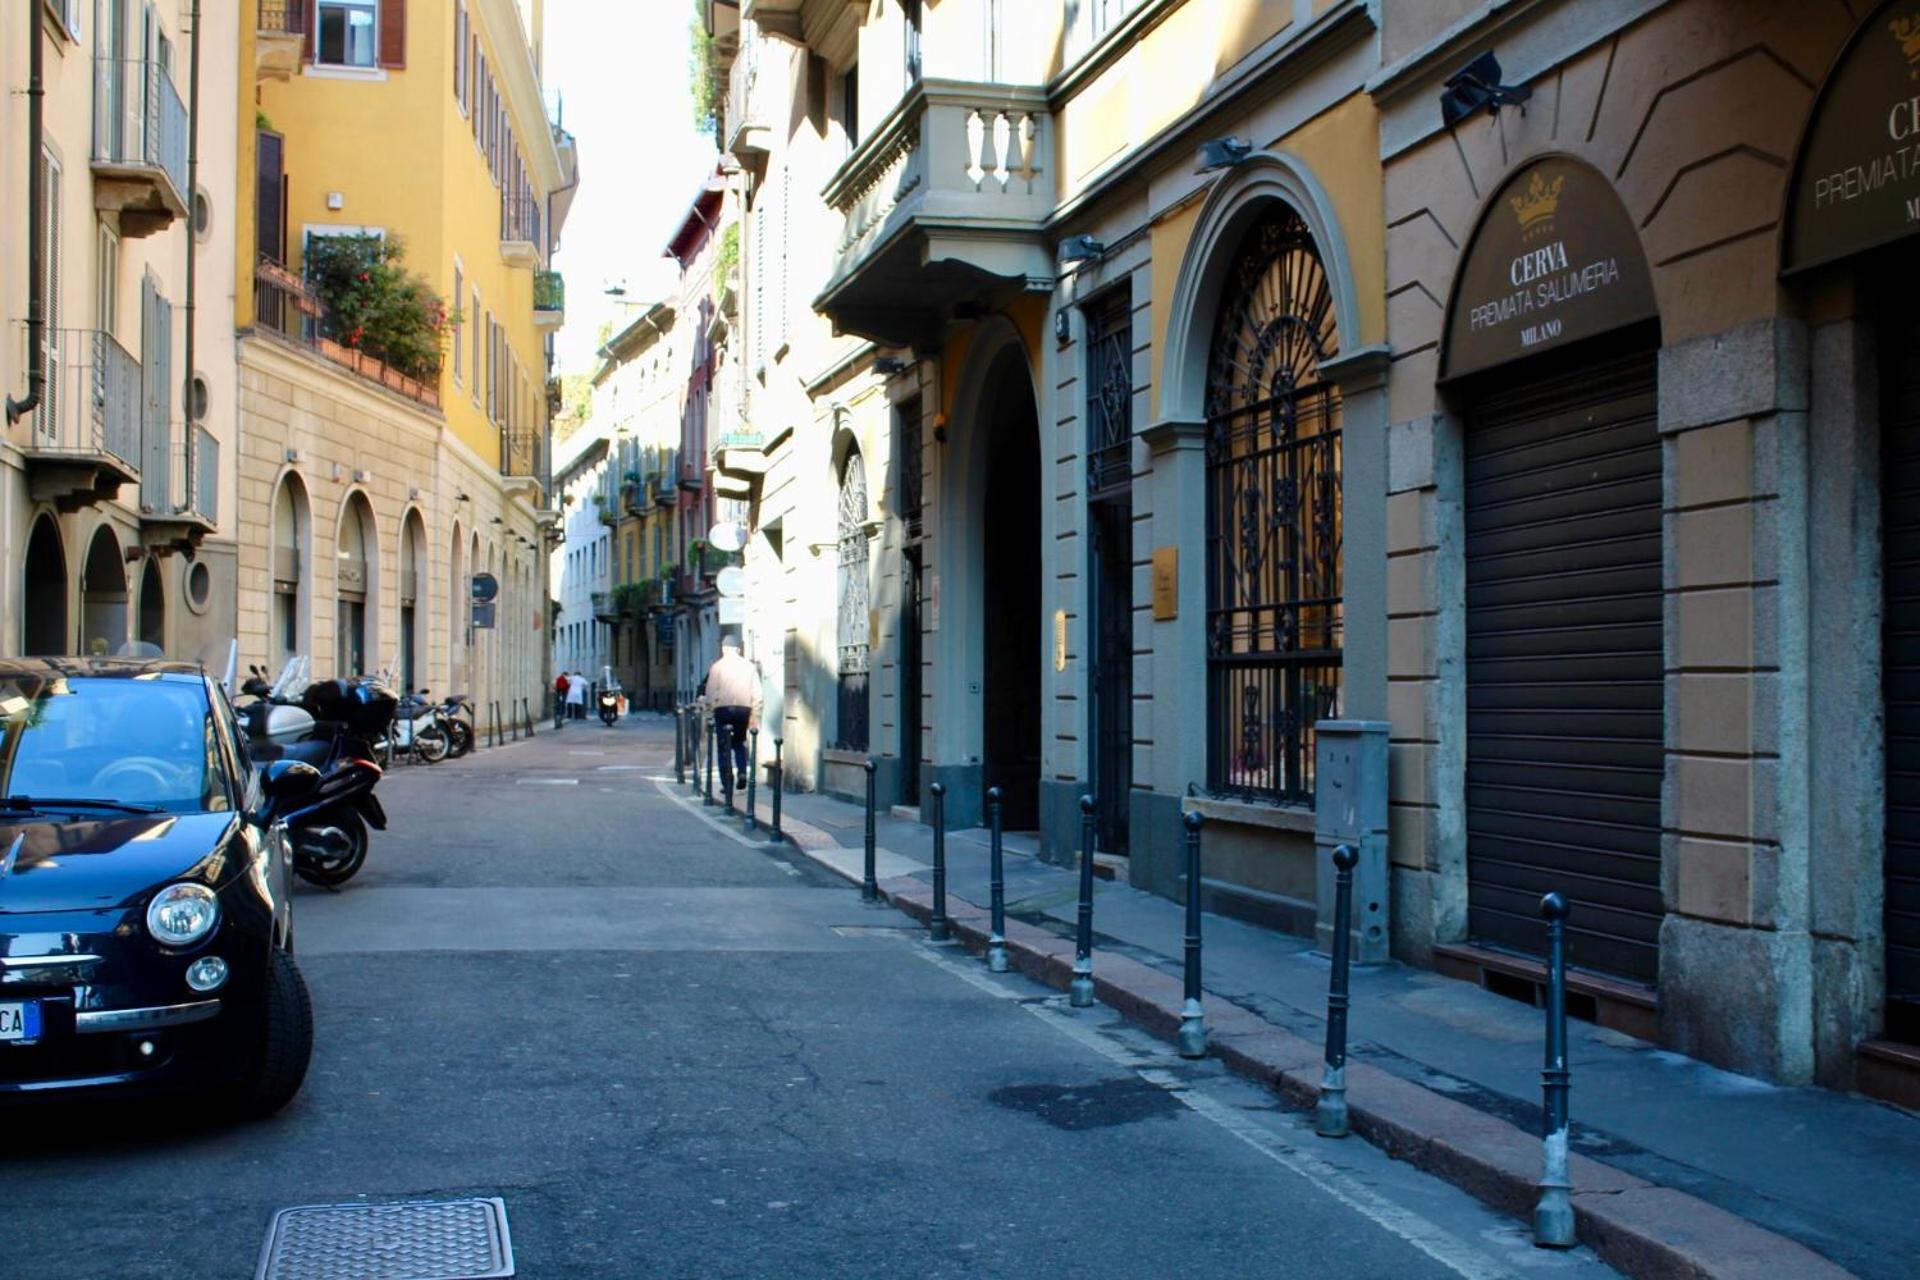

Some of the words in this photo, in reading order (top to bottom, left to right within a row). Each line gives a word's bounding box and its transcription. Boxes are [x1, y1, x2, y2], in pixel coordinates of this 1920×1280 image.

[1510, 241, 1568, 286] CERVA
[1470, 289, 1534, 331] PREMIATA
[1537, 257, 1620, 307] SALUMERIA
[1520, 319, 1562, 347] MILANO
[0, 1010, 22, 1032] CA
